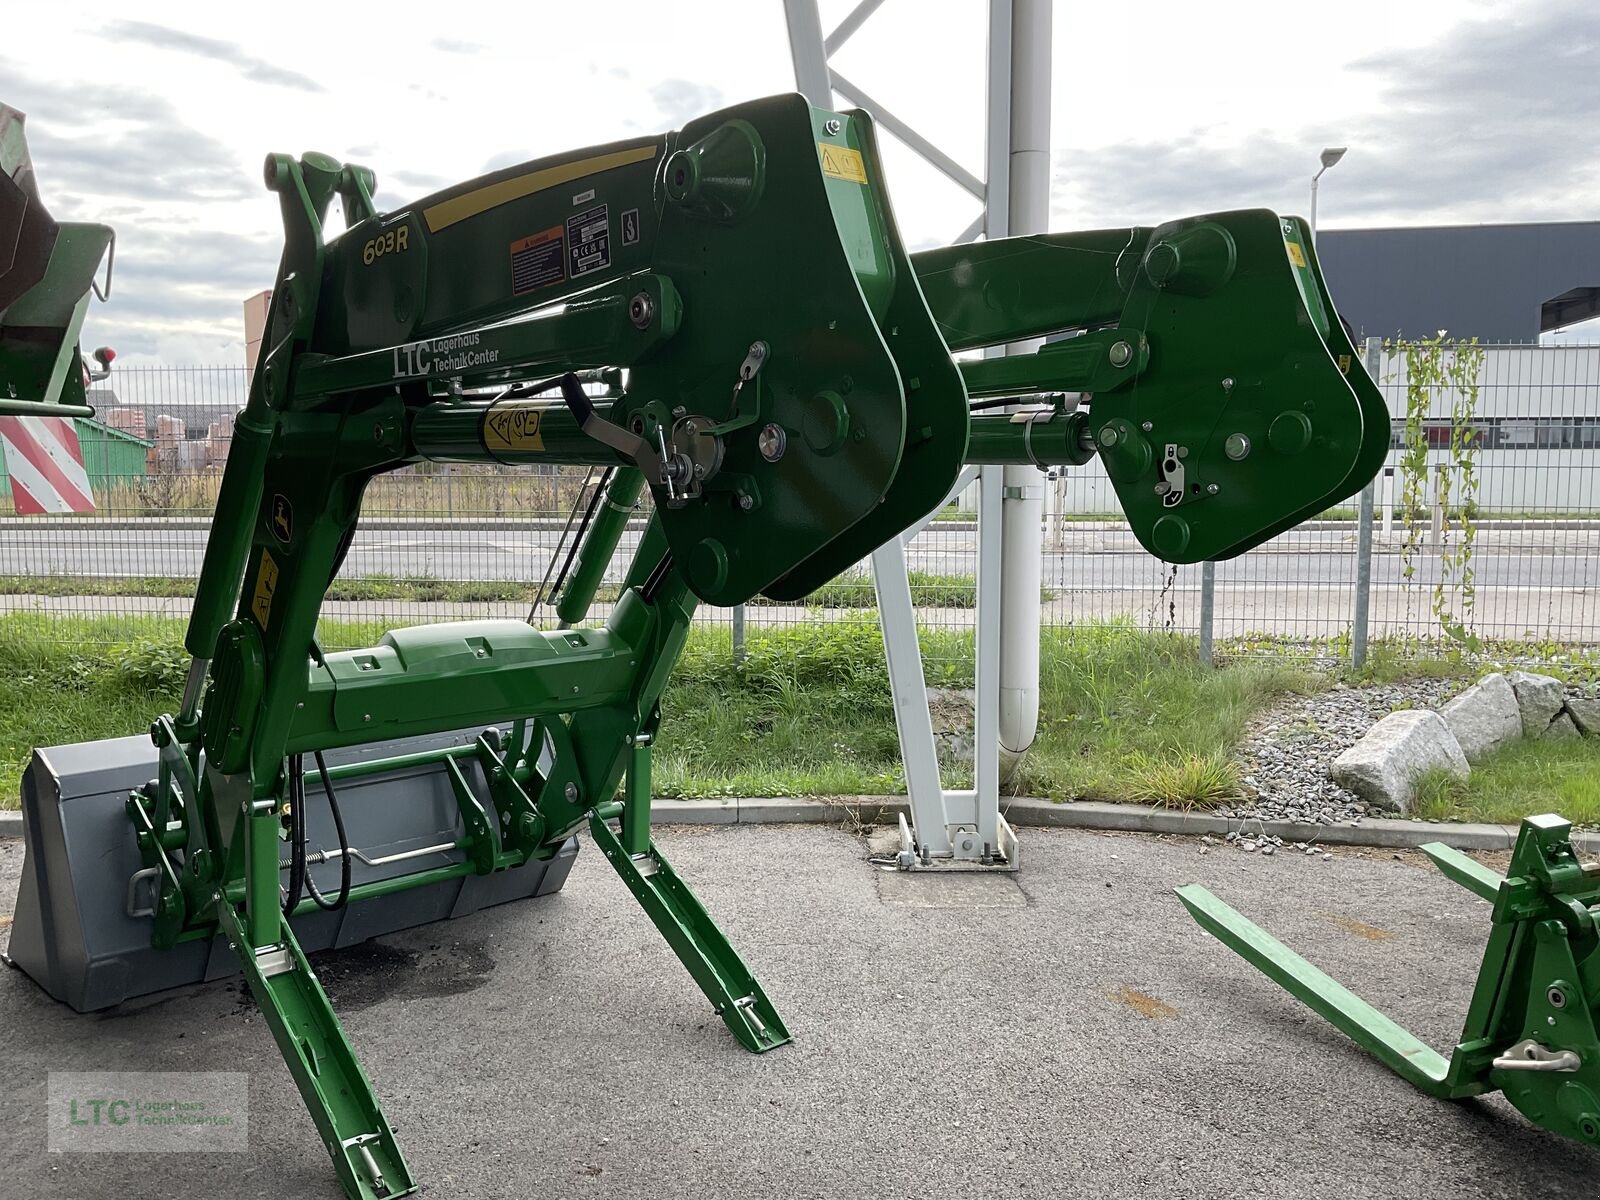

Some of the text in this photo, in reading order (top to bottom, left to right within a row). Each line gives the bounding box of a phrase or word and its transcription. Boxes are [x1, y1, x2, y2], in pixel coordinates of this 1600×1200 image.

[363, 225, 409, 265] 603R
[432, 333, 480, 354] Lagerhaus
[393, 342, 431, 377] LTC
[433, 349, 499, 372] TechnikCenter
